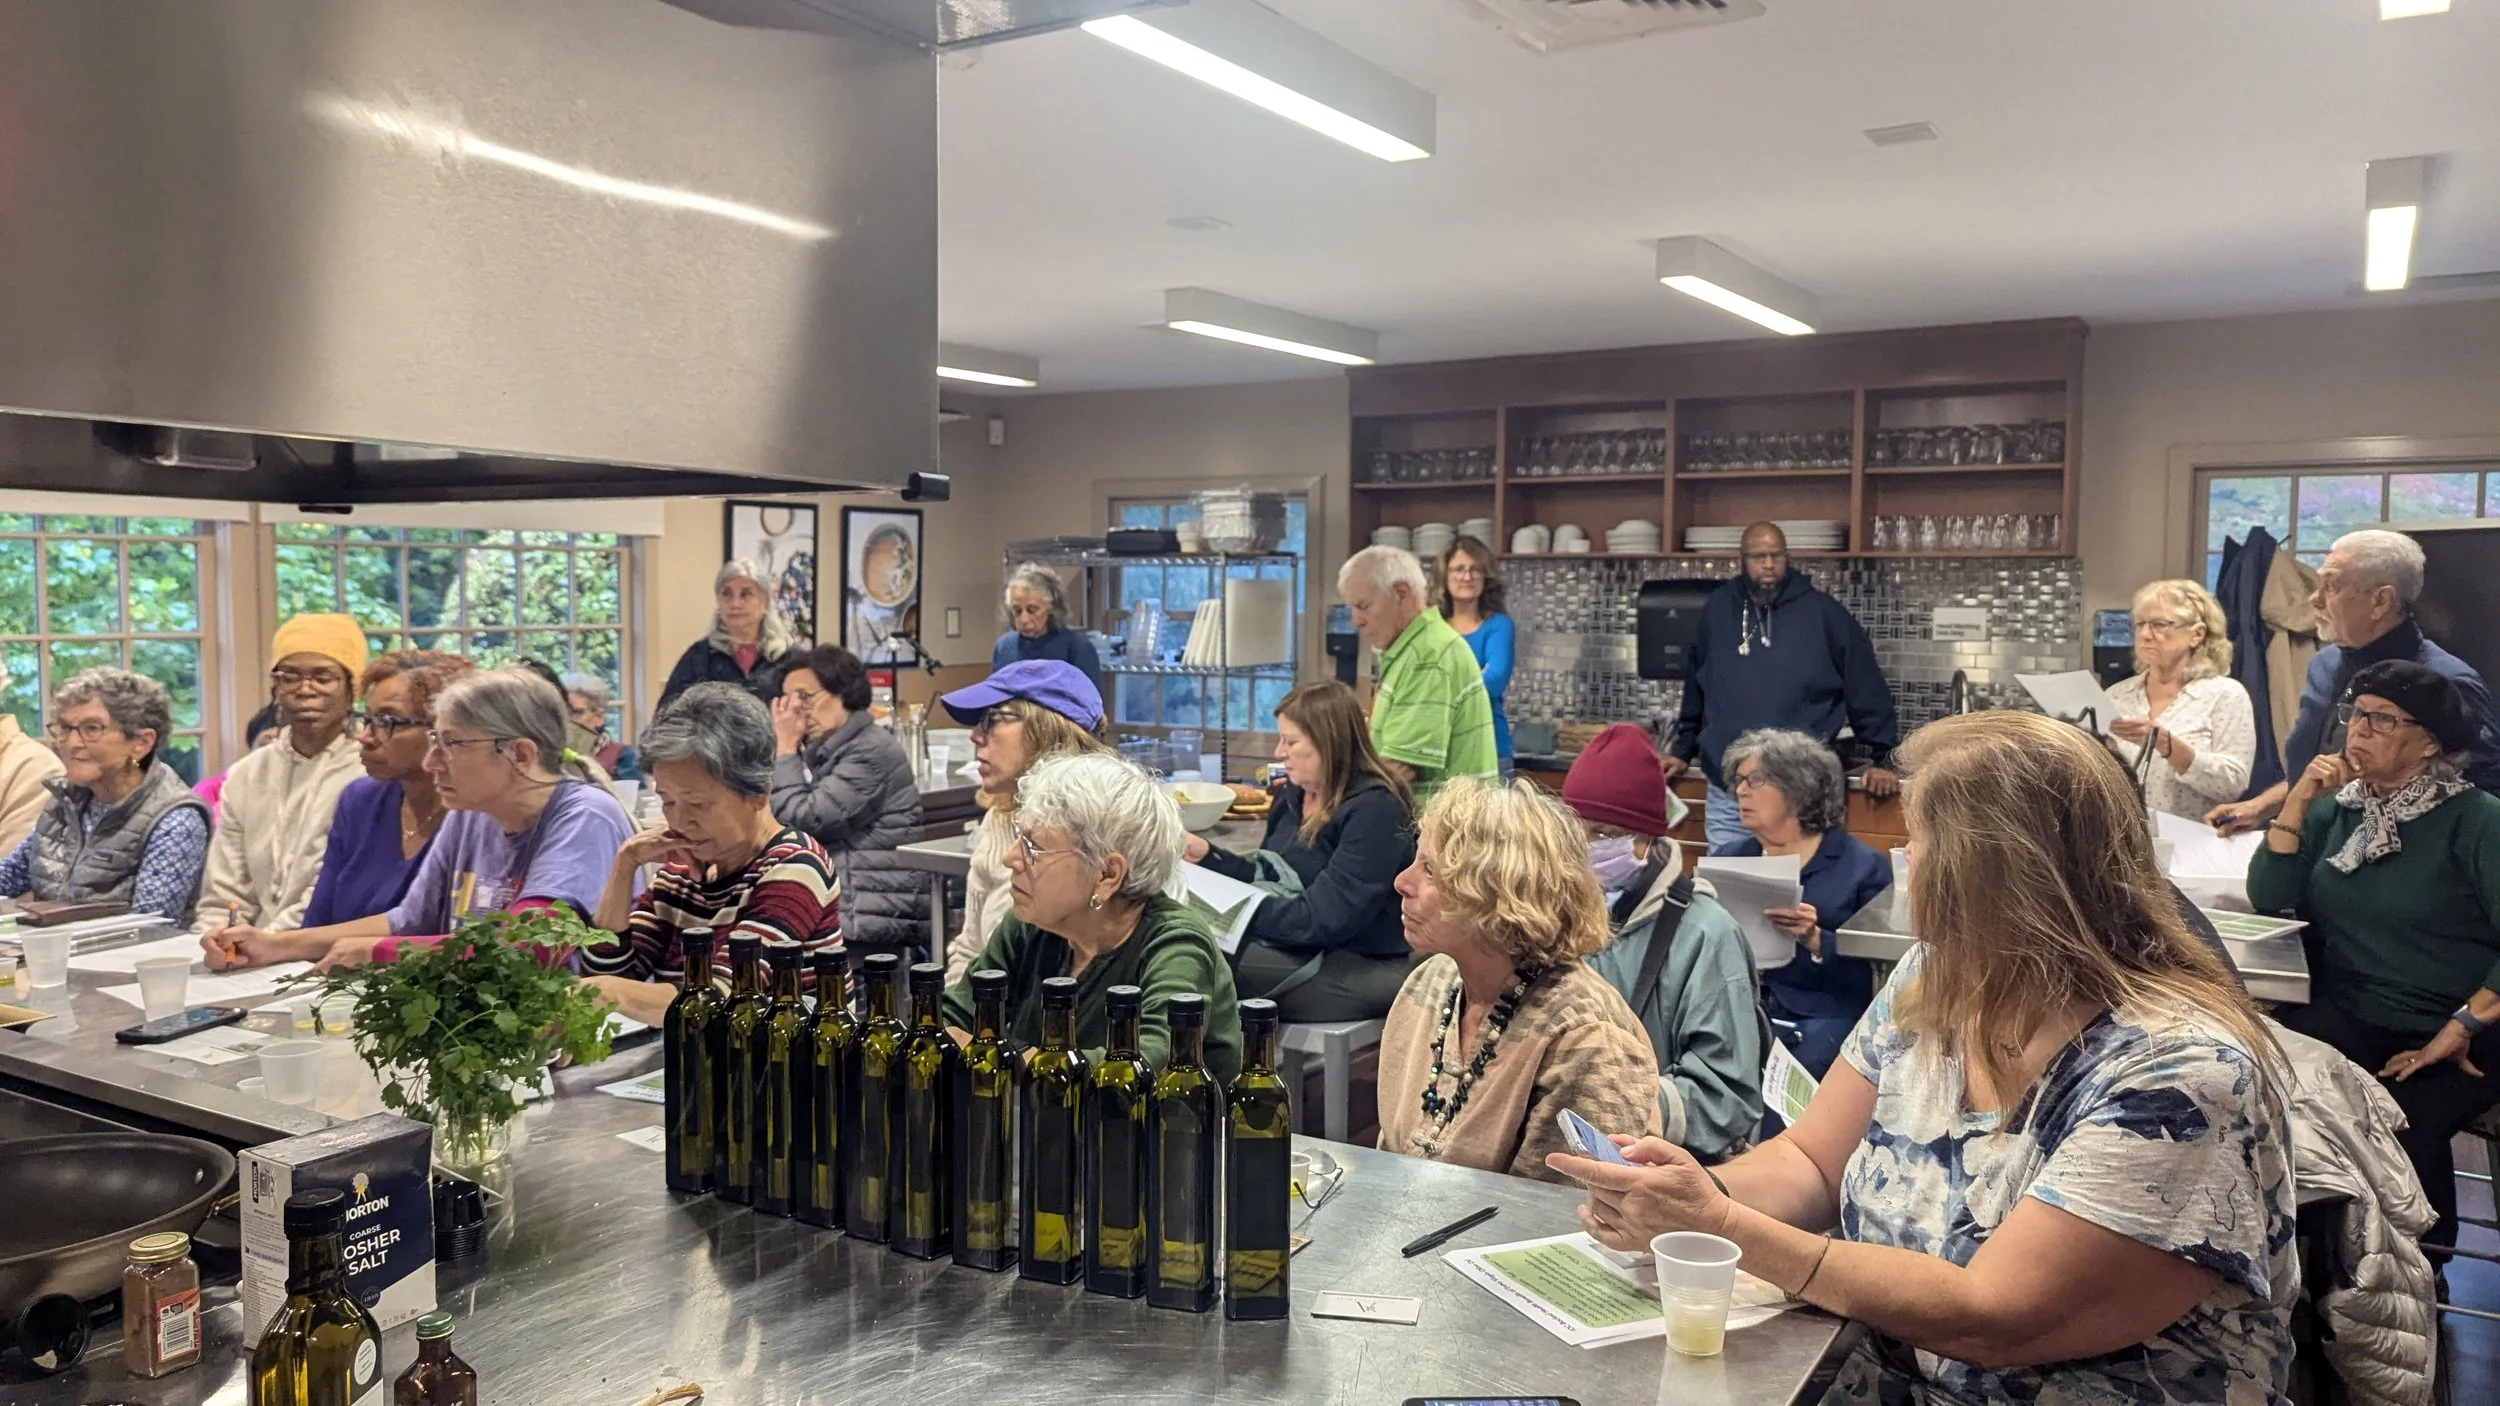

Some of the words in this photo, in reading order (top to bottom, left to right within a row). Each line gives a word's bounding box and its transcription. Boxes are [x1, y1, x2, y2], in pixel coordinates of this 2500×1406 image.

[342, 1228, 400, 1261] OSHER
[349, 1224, 381, 1241] COARSE
[348, 1250, 389, 1275] SALT
